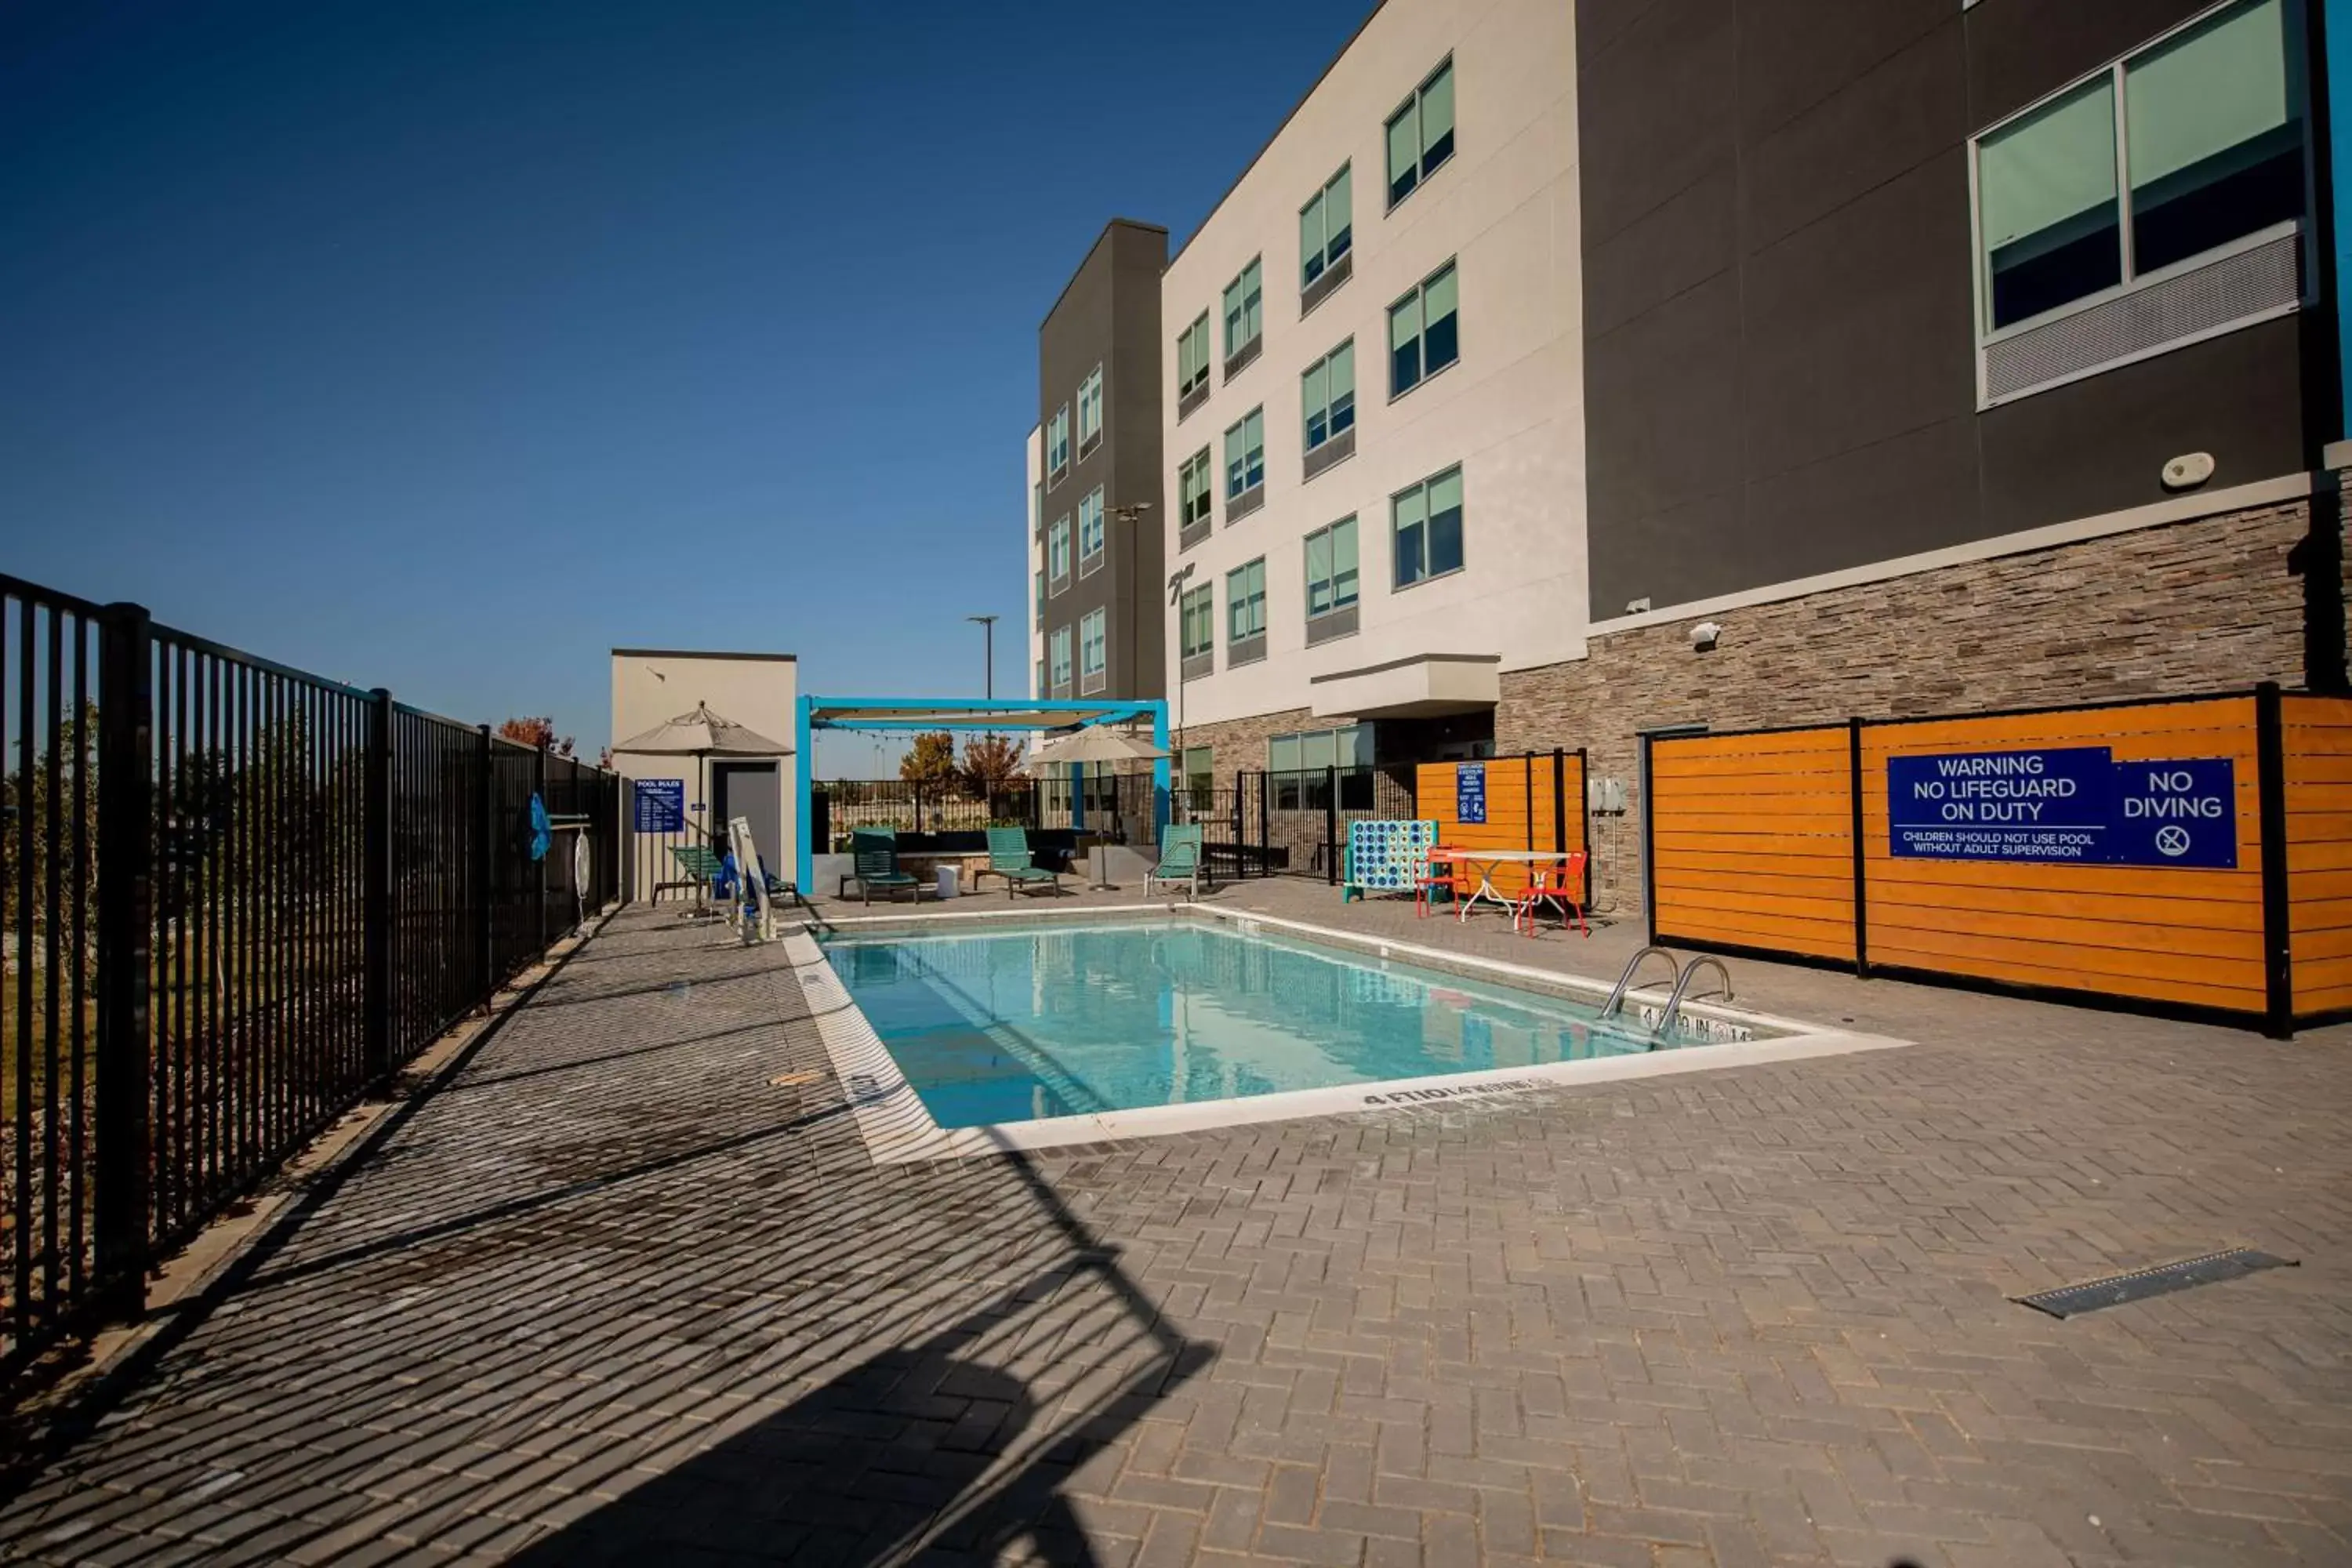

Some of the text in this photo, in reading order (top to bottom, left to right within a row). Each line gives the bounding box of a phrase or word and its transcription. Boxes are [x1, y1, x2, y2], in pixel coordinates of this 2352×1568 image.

[1937, 755, 2044, 777] WARNING
[1914, 778, 2076, 799] NO LIFEGUARD
[2149, 771, 2193, 792] NO
[1941, 802, 2044, 821] ON DUTY
[2124, 797, 2223, 818] DIVING
[1903, 831, 2096, 845] CHILDREN SHOULD NOT USE POOL
[1913, 843, 2082, 856] WITHOUT ADULT SUPERVISION
